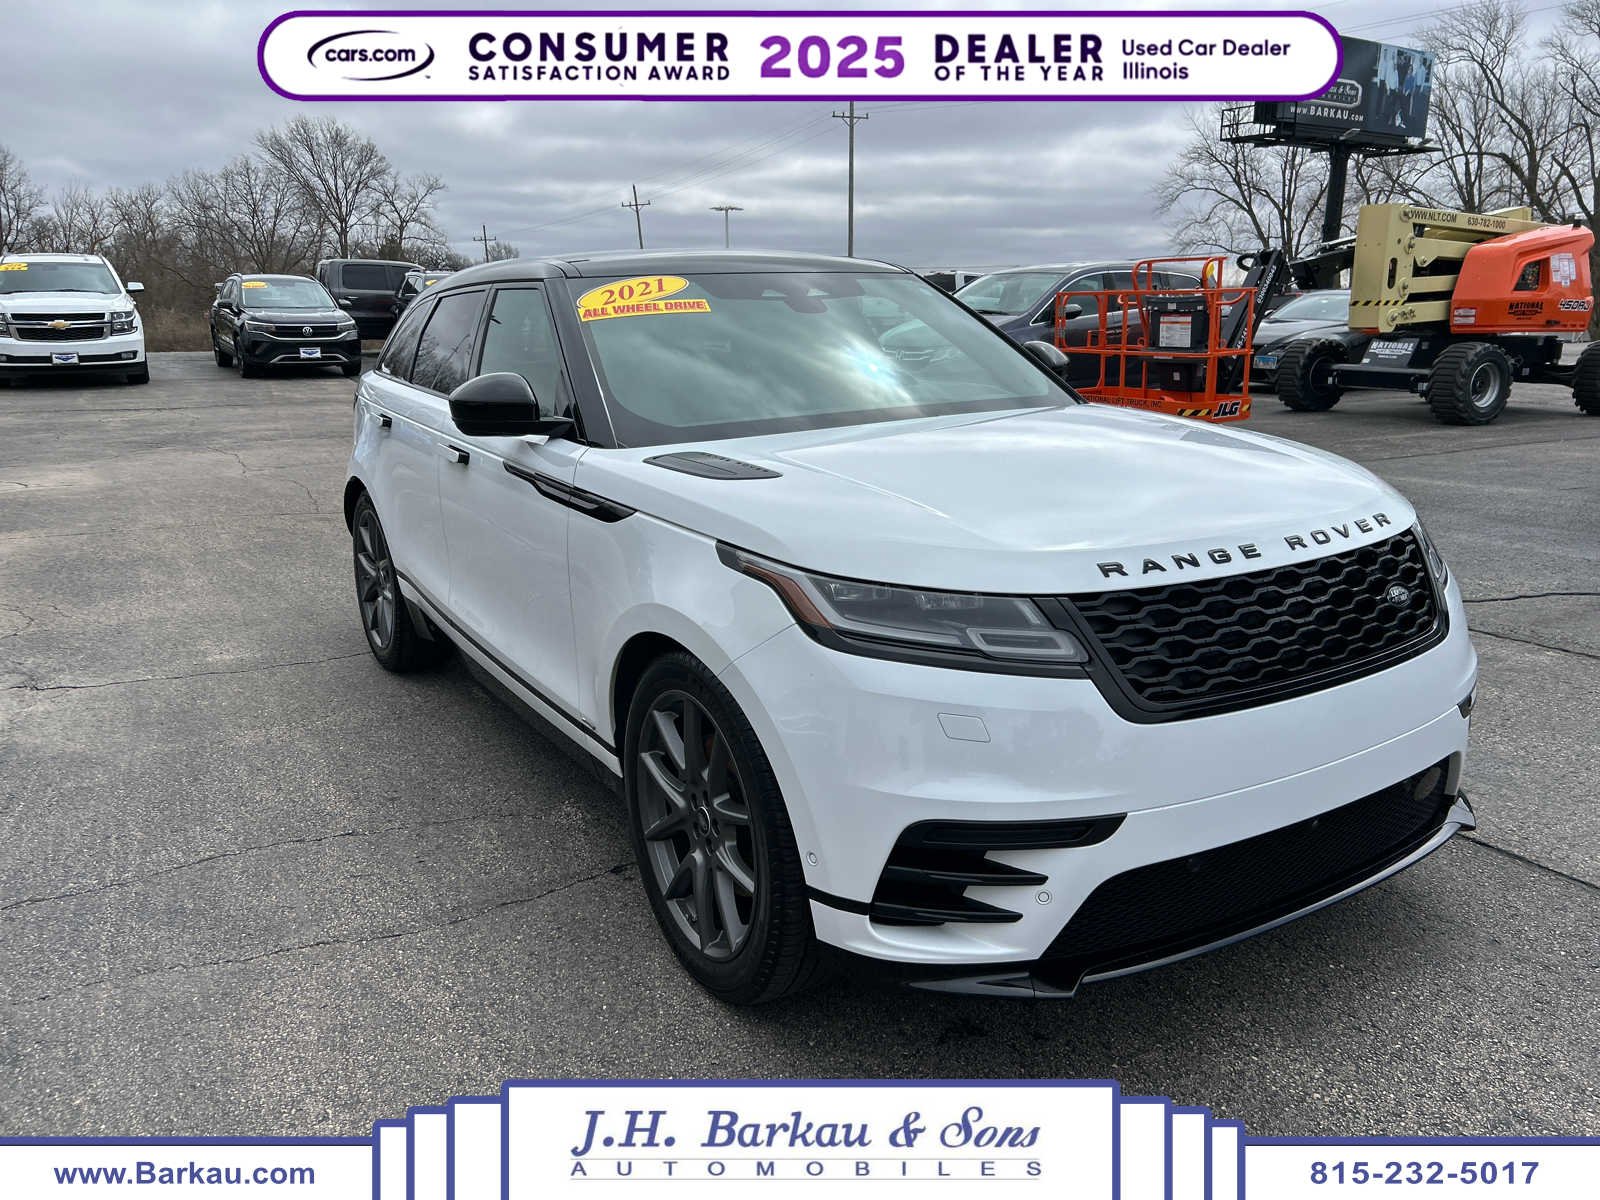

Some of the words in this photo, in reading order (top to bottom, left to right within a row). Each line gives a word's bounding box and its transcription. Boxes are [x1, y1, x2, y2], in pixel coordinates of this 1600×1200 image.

[601, 278, 665, 306] 2021
[582, 308, 610, 319] ALL
[613, 303, 662, 315] WHEEL
[664, 300, 706, 311] DRIVE
[1370, 341, 1414, 351] NATIONAL
[1213, 402, 1240, 418] JLG
[1097, 543, 1262, 578] RANGE
[1284, 512, 1391, 551] ROVER
